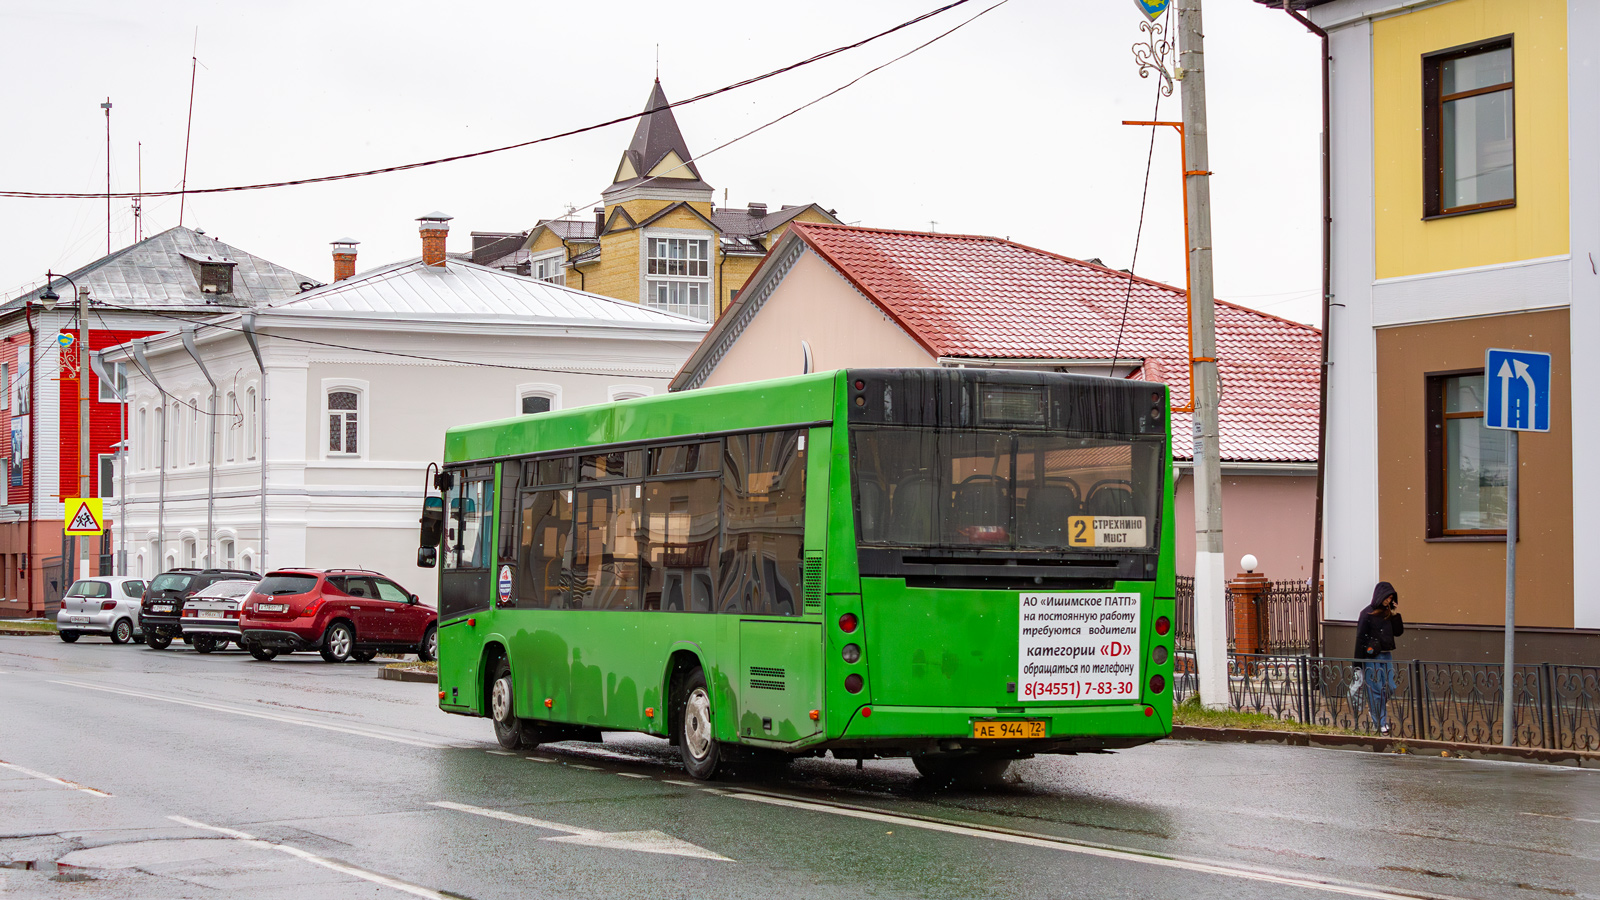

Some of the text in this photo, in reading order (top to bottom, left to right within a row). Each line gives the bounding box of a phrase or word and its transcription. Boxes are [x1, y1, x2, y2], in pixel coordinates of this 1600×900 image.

[1074, 519, 1142, 543] 2 СТРЕХНИНО
[1103, 533, 1127, 543] МОСТ
[1023, 596, 1137, 606] АО «Ишимское ПАТП»
[1023, 611, 1135, 623] на постоянную работу
[1022, 625, 1136, 637] требуются водители
[1026, 641, 1132, 659] категории «D»
[1023, 662, 1134, 677] обращаться по телефону
[1024, 680, 1133, 699] 8(34551) 7-83-30
[1000, 723, 1023, 736] 944
[1029, 722, 1041, 732] 72
